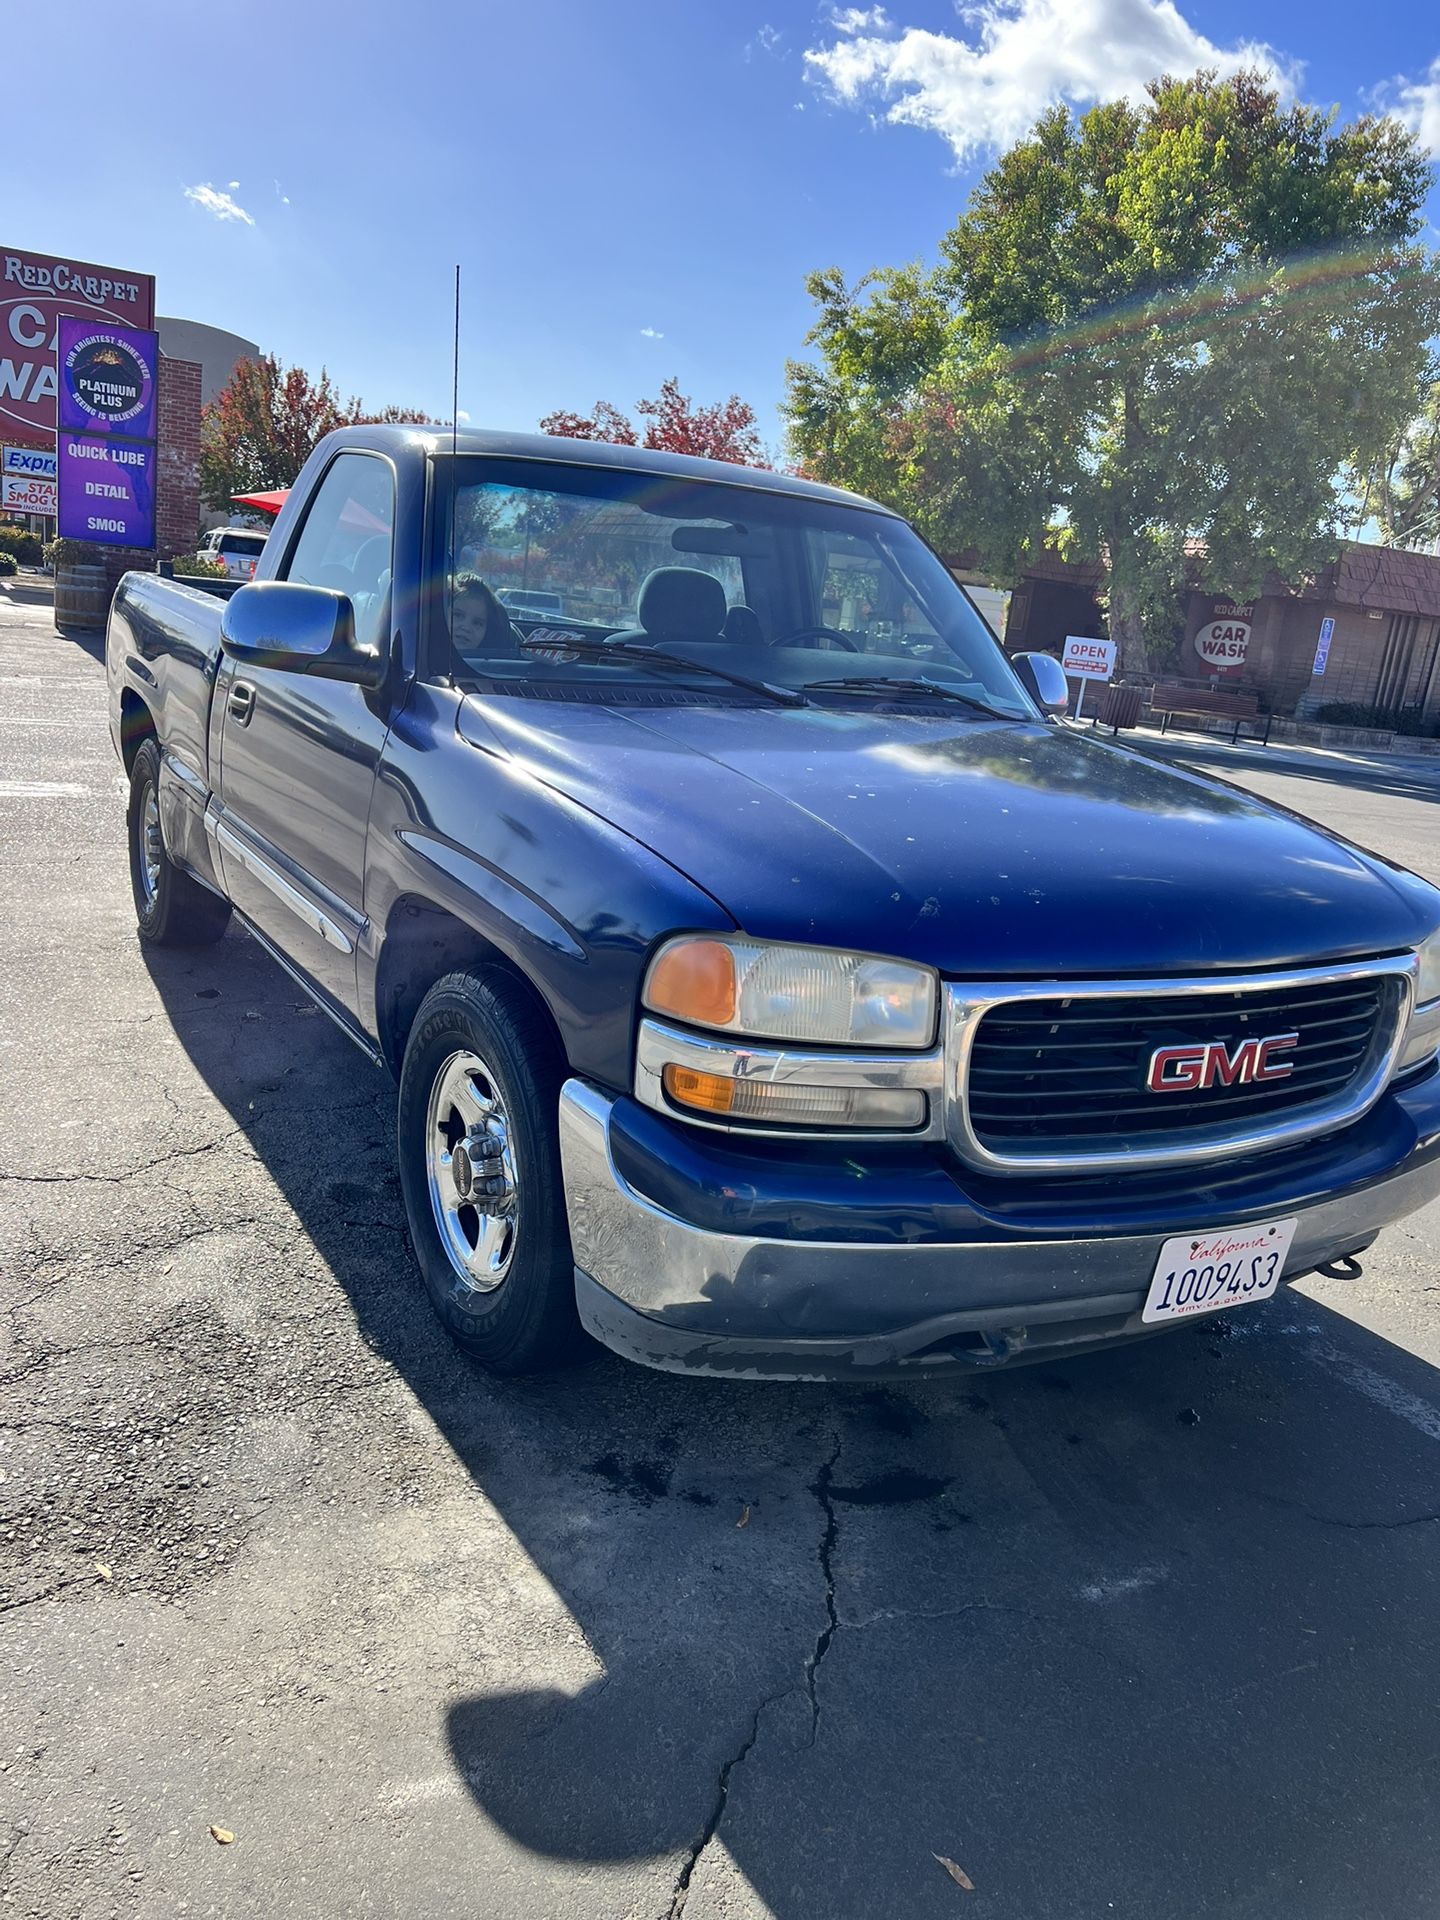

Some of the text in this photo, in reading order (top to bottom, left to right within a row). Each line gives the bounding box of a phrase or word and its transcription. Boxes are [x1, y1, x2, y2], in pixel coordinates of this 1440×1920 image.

[8, 304, 56, 351] C
[65, 335, 151, 380] OUR BRIGHTEST SHINE EVER
[79, 378, 136, 398] PLATINUM
[72, 392, 145, 422] SEEING IS BELIEVING
[93, 393, 123, 408] PLUS
[67, 443, 145, 467] QUICK LUBE
[8, 491, 48, 505] SMOG
[85, 482, 130, 500] DETAIL
[87, 516, 126, 534] SMOG
[1211, 625, 1246, 642] CAR
[1070, 643, 1107, 658] OPEN
[1202, 641, 1248, 659] WASH
[1147, 1032, 1300, 1093] GMC
[1189, 1235, 1270, 1262] California
[1156, 1251, 1279, 1311] 10094S3
[1177, 1294, 1245, 1313] dmv.ca.gov
